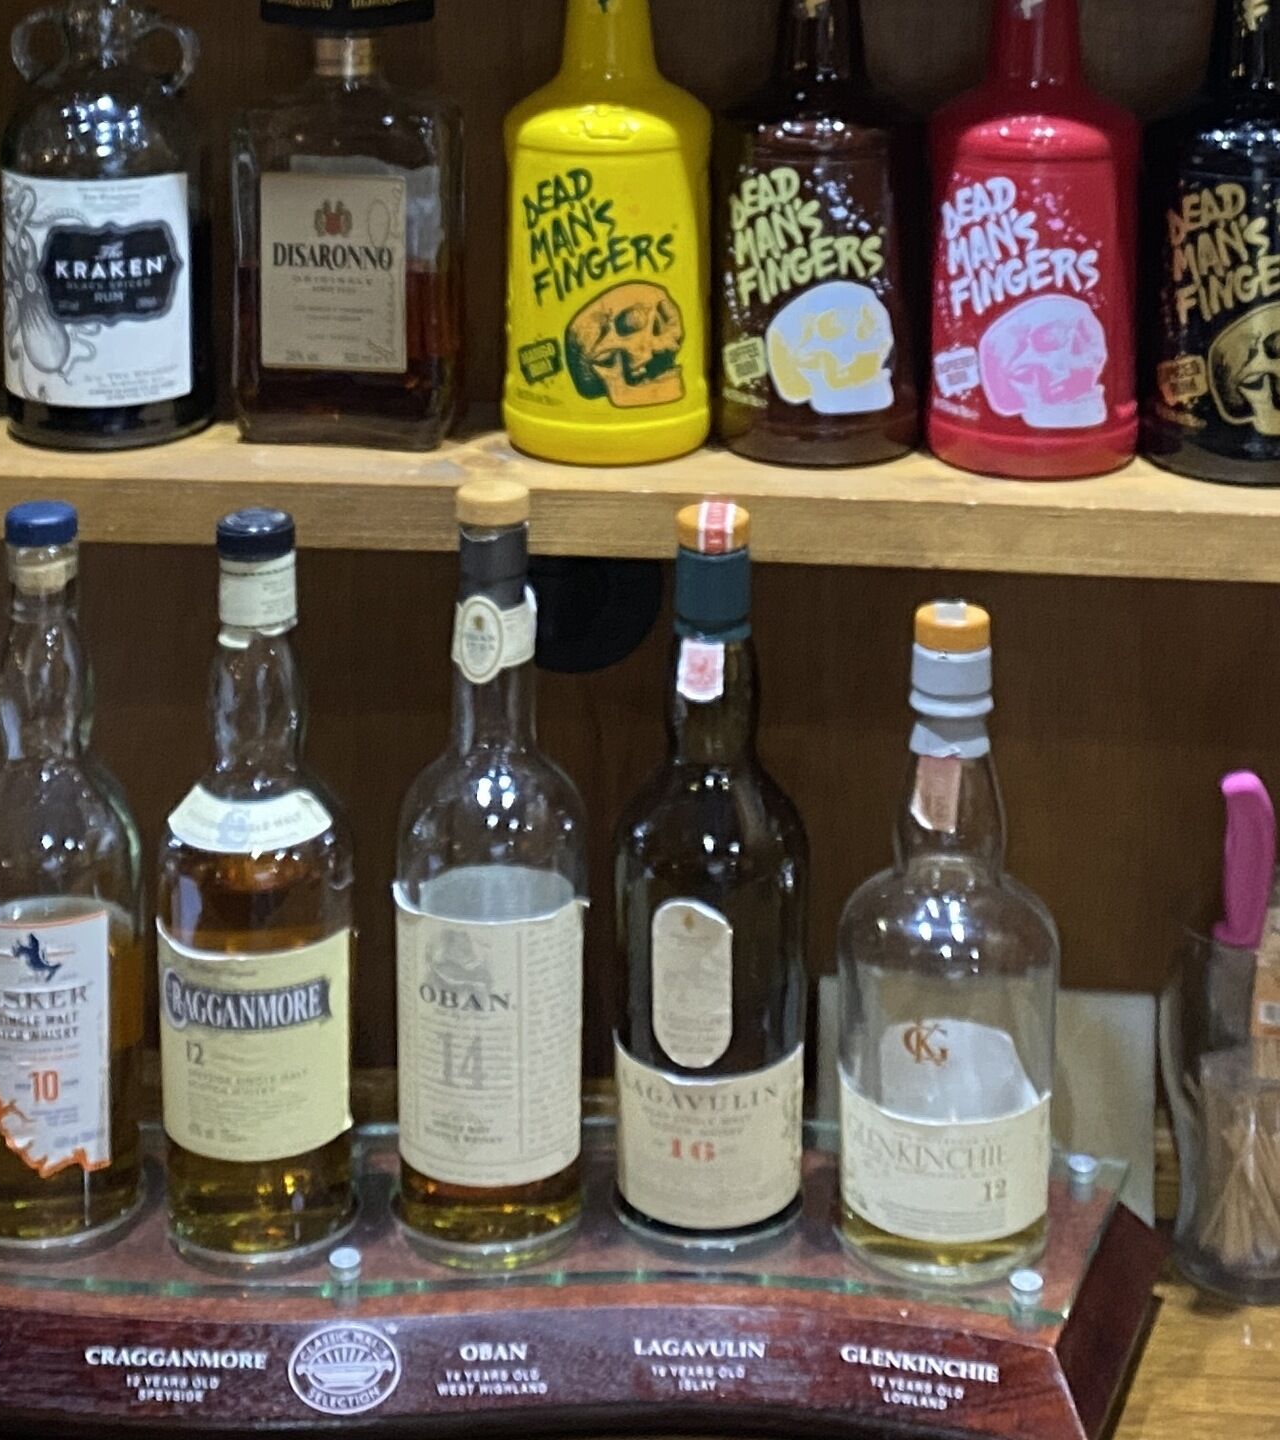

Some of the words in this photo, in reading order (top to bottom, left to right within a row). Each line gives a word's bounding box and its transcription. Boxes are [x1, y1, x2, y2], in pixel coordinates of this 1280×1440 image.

[523, 166, 592, 229] DEAD
[730, 166, 799, 230] DEAD
[941, 176, 1017, 239] DEAD
[1170, 182, 1248, 246] DEAD
[528, 197, 616, 267] MAN'S
[734, 198, 823, 268] MAN'S
[946, 209, 1039, 276] MAN'S
[272, 241, 395, 272] DISARONNO
[1171, 215, 1269, 284] MAN'S
[54, 255, 165, 280] KRAKEN
[532, 233, 675, 307] FINGERS
[737, 235, 884, 308] FINGERS
[950, 247, 1099, 318] FINGERS
[92, 290, 125, 304] RUM
[164, 966, 322, 1032] CRAGGANMORE
[419, 984, 514, 1012] OBAN
[45, 1012, 78, 1026] MALT
[185, 1038, 205, 1066] 12
[27, 1069, 60, 1104] 10
[671, 1137, 716, 1163] 16
[983, 1178, 1008, 1203] 12
[84, 1346, 269, 1370] CRAGGANMORE
[458, 1341, 529, 1362] OBAN
[633, 1336, 767, 1360] LAGAVULIN
[463, 1368, 510, 1382] YEARS
[669, 1364, 715, 1379] YEARS
[839, 1344, 1001, 1383] GLENKINCHIE
[137, 1388, 206, 1403] SPEYSIDE
[144, 1374, 188, 1389] YEARS
[191, 1375, 221, 1390] OLD
[887, 1375, 934, 1396] YEARS
[305, 1386, 382, 1410] SELECTION
[882, 1390, 949, 1411] LOWLAND
